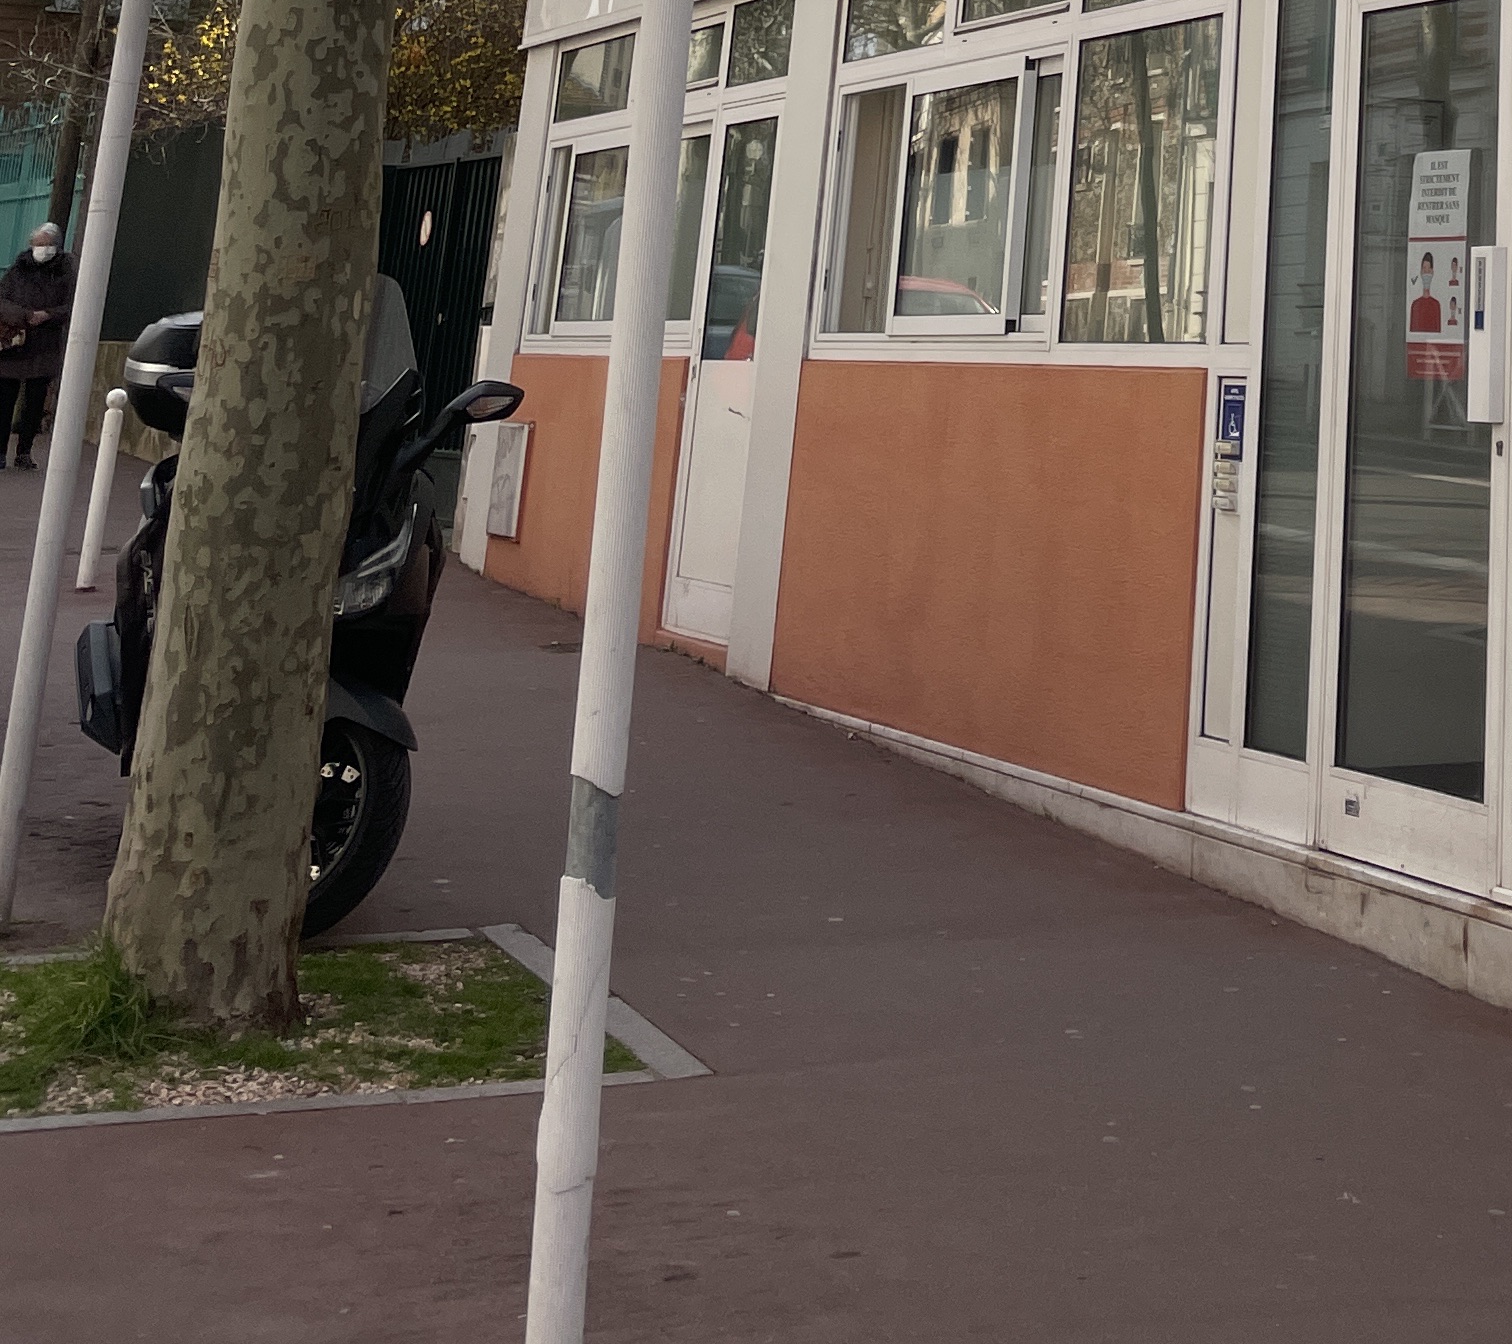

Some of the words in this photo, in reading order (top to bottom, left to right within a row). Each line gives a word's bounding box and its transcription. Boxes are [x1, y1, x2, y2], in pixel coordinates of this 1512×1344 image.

[1437, 160, 1448, 170] EST
[1420, 174, 1460, 184] STRICTEMENT
[1421, 187, 1447, 197] INTERDIT
[1448, 186, 1457, 196] DE
[1417, 201, 1443, 211] RENTRER
[1444, 200, 1460, 210] SANS
[1425, 213, 1450, 225] MASQUE
